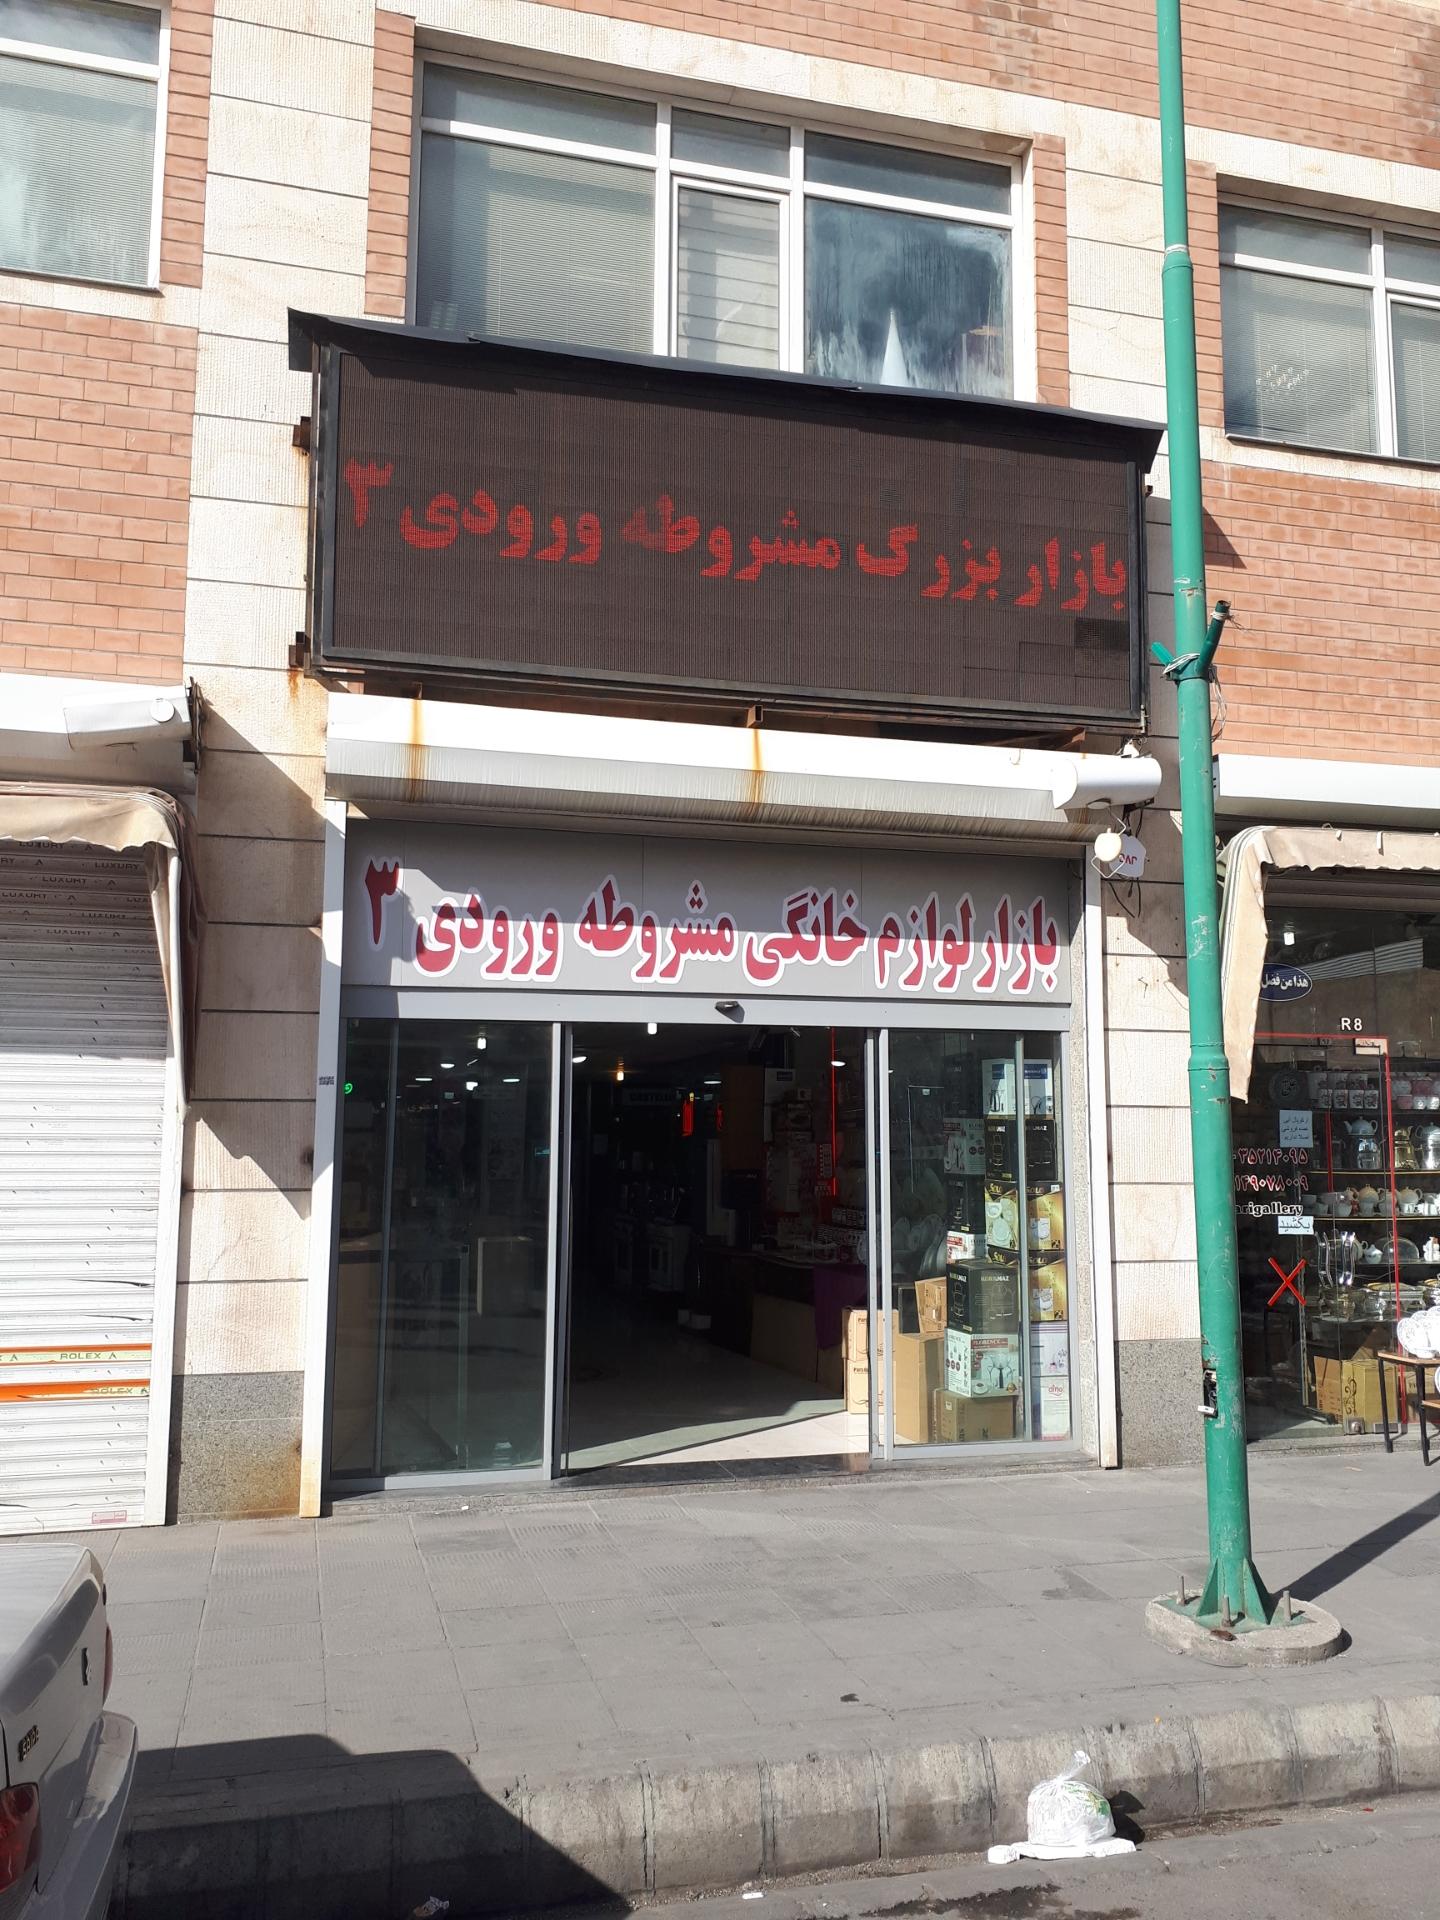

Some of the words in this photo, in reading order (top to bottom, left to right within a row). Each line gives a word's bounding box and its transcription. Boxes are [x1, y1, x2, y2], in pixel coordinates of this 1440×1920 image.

[343, 457, 395, 529] ۳
[400, 489, 603, 565] ورودی
[620, 494, 842, 582] مشروطه
[856, 523, 1001, 600] بزرگ
[1015, 537, 1127, 613] بازار
[364, 858, 401, 946] ۳
[414, 892, 562, 977] ورودی
[577, 878, 738, 979] مشروطه
[745, 889, 869, 983] خانگی
[875, 896, 975, 990] لوازم
[975, 896, 1060, 990] بازار
[1293, 974, 1309, 988] هذا
[1280, 978, 1293, 990] من
[1341, 1017, 1352, 1031] R
[1353, 1017, 1363, 1031] 8
[60, 1352, 101, 1360] ROLEX
